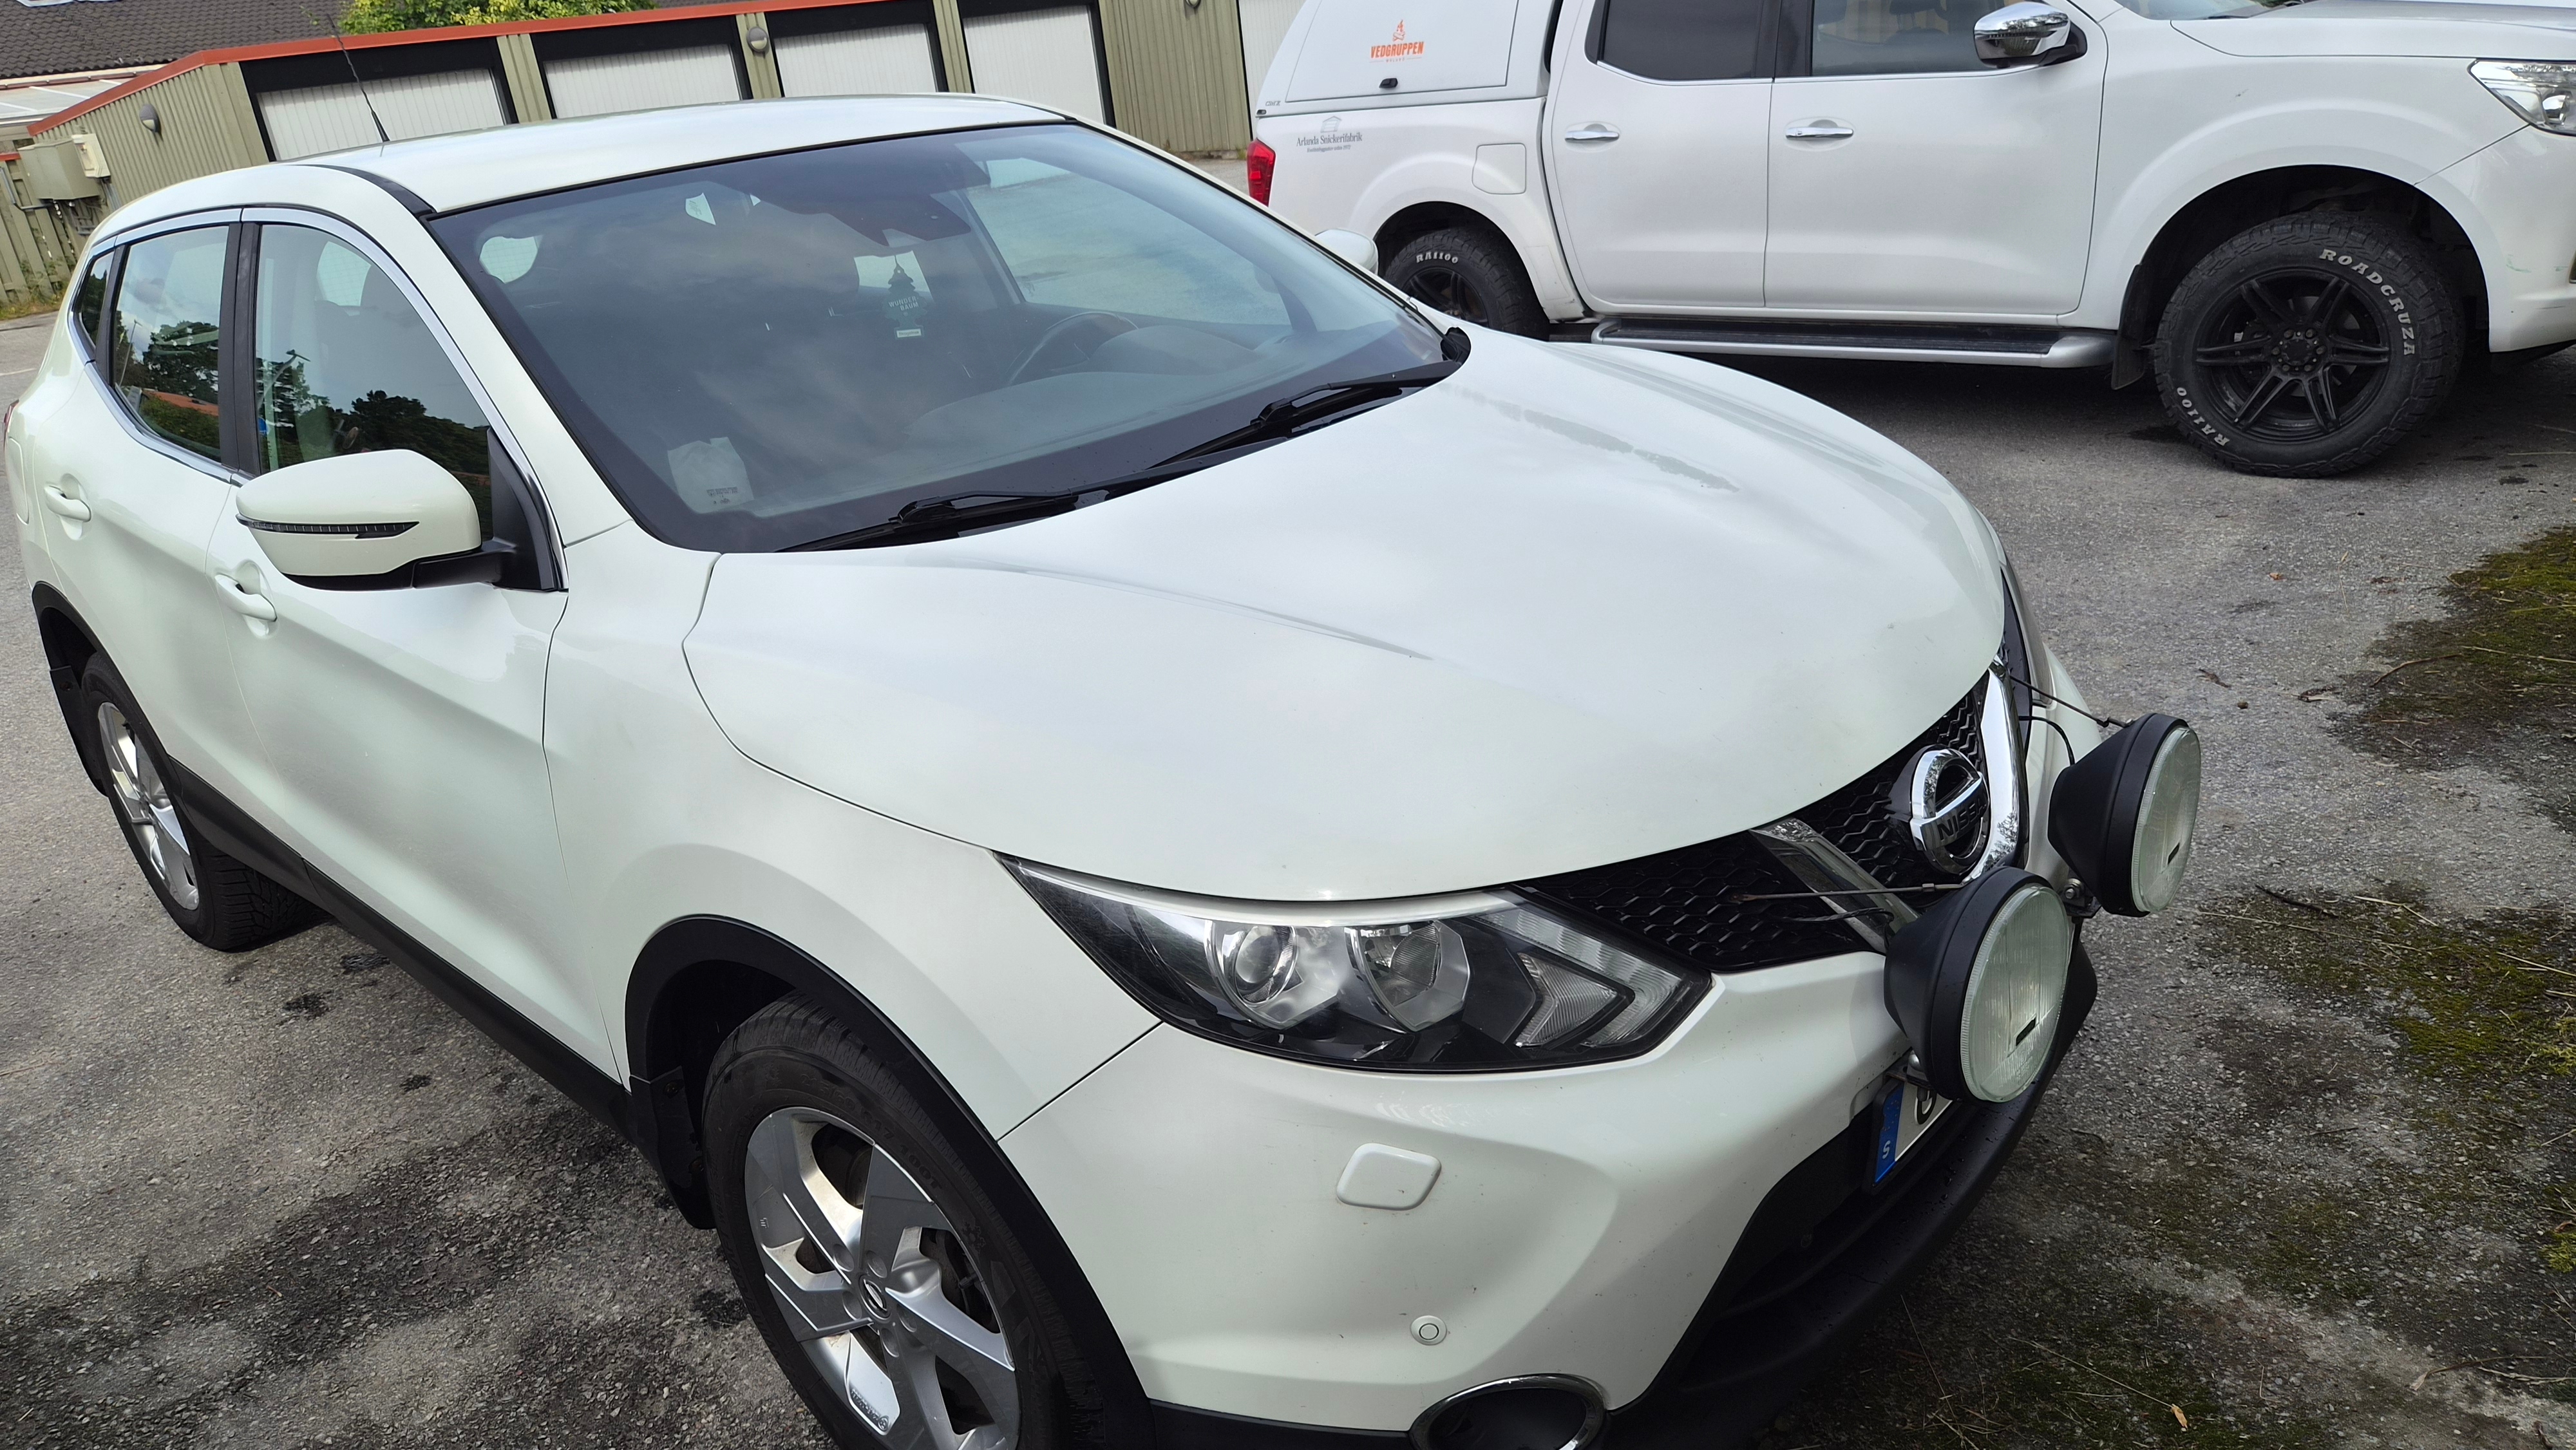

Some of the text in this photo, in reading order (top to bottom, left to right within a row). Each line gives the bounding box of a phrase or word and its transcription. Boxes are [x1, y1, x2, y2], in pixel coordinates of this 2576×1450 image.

[1370, 41, 1425, 59] VEDGRUPPEN
[1296, 132, 1363, 147] Arlanda Snickerifabrik
[900, 302, 919, 311] BAUM
[2319, 249, 2416, 355] ROADCRUZA
[1937, 795, 1987, 841] NISSA
[1882, 1140, 1891, 1160] S
